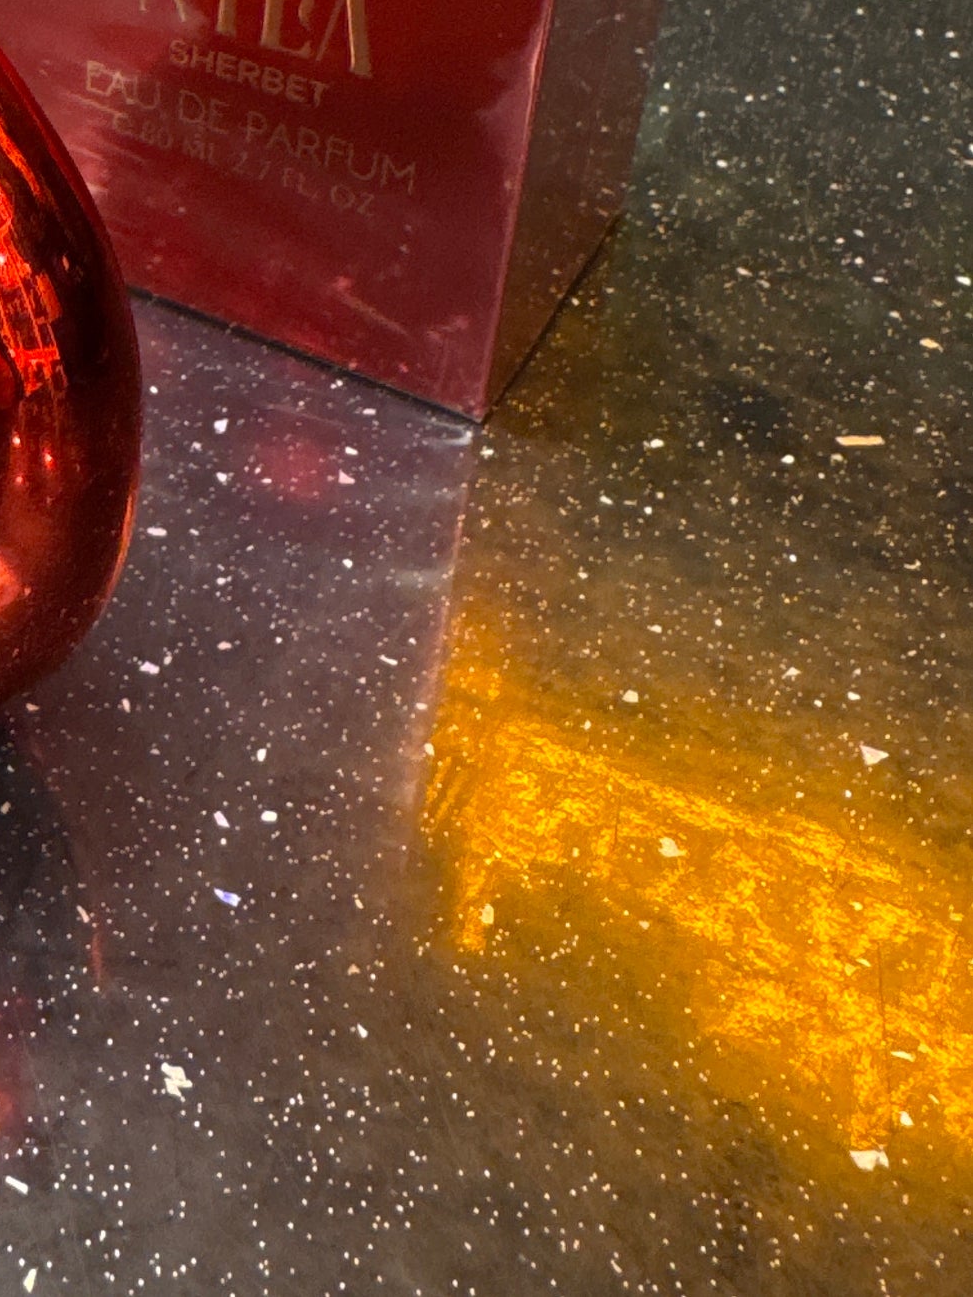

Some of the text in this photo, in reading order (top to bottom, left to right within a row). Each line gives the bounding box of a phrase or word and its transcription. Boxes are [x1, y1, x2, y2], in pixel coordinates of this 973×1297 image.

[168, 38, 330, 108] SHERBET
[85, 59, 417, 197] EAU DE PARFUM
